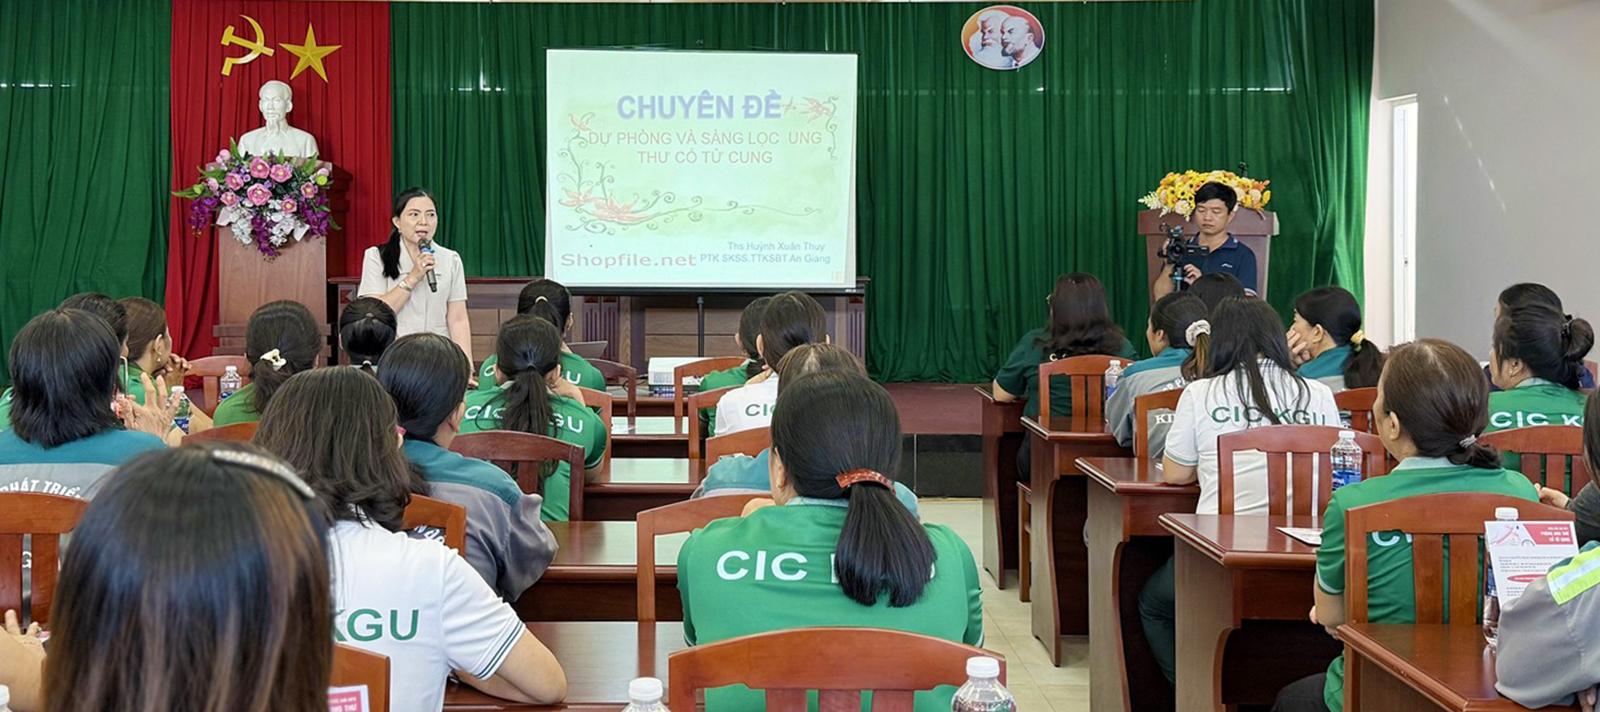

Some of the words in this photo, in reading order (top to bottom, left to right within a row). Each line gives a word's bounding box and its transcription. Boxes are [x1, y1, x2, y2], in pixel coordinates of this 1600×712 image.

[616, 89, 734, 120] CHUYÊN
[741, 88, 782, 119] ĐỀ
[748, 131, 779, 147] LỌC
[637, 151, 670, 164] THƯ
[728, 151, 773, 164] CUNG
[560, 253, 697, 269] Shopfile.net
[804, 253, 830, 264] Giang
[548, 412, 584, 433] GU
[1490, 411, 1549, 428] CIC
[716, 550, 808, 581] CIC
